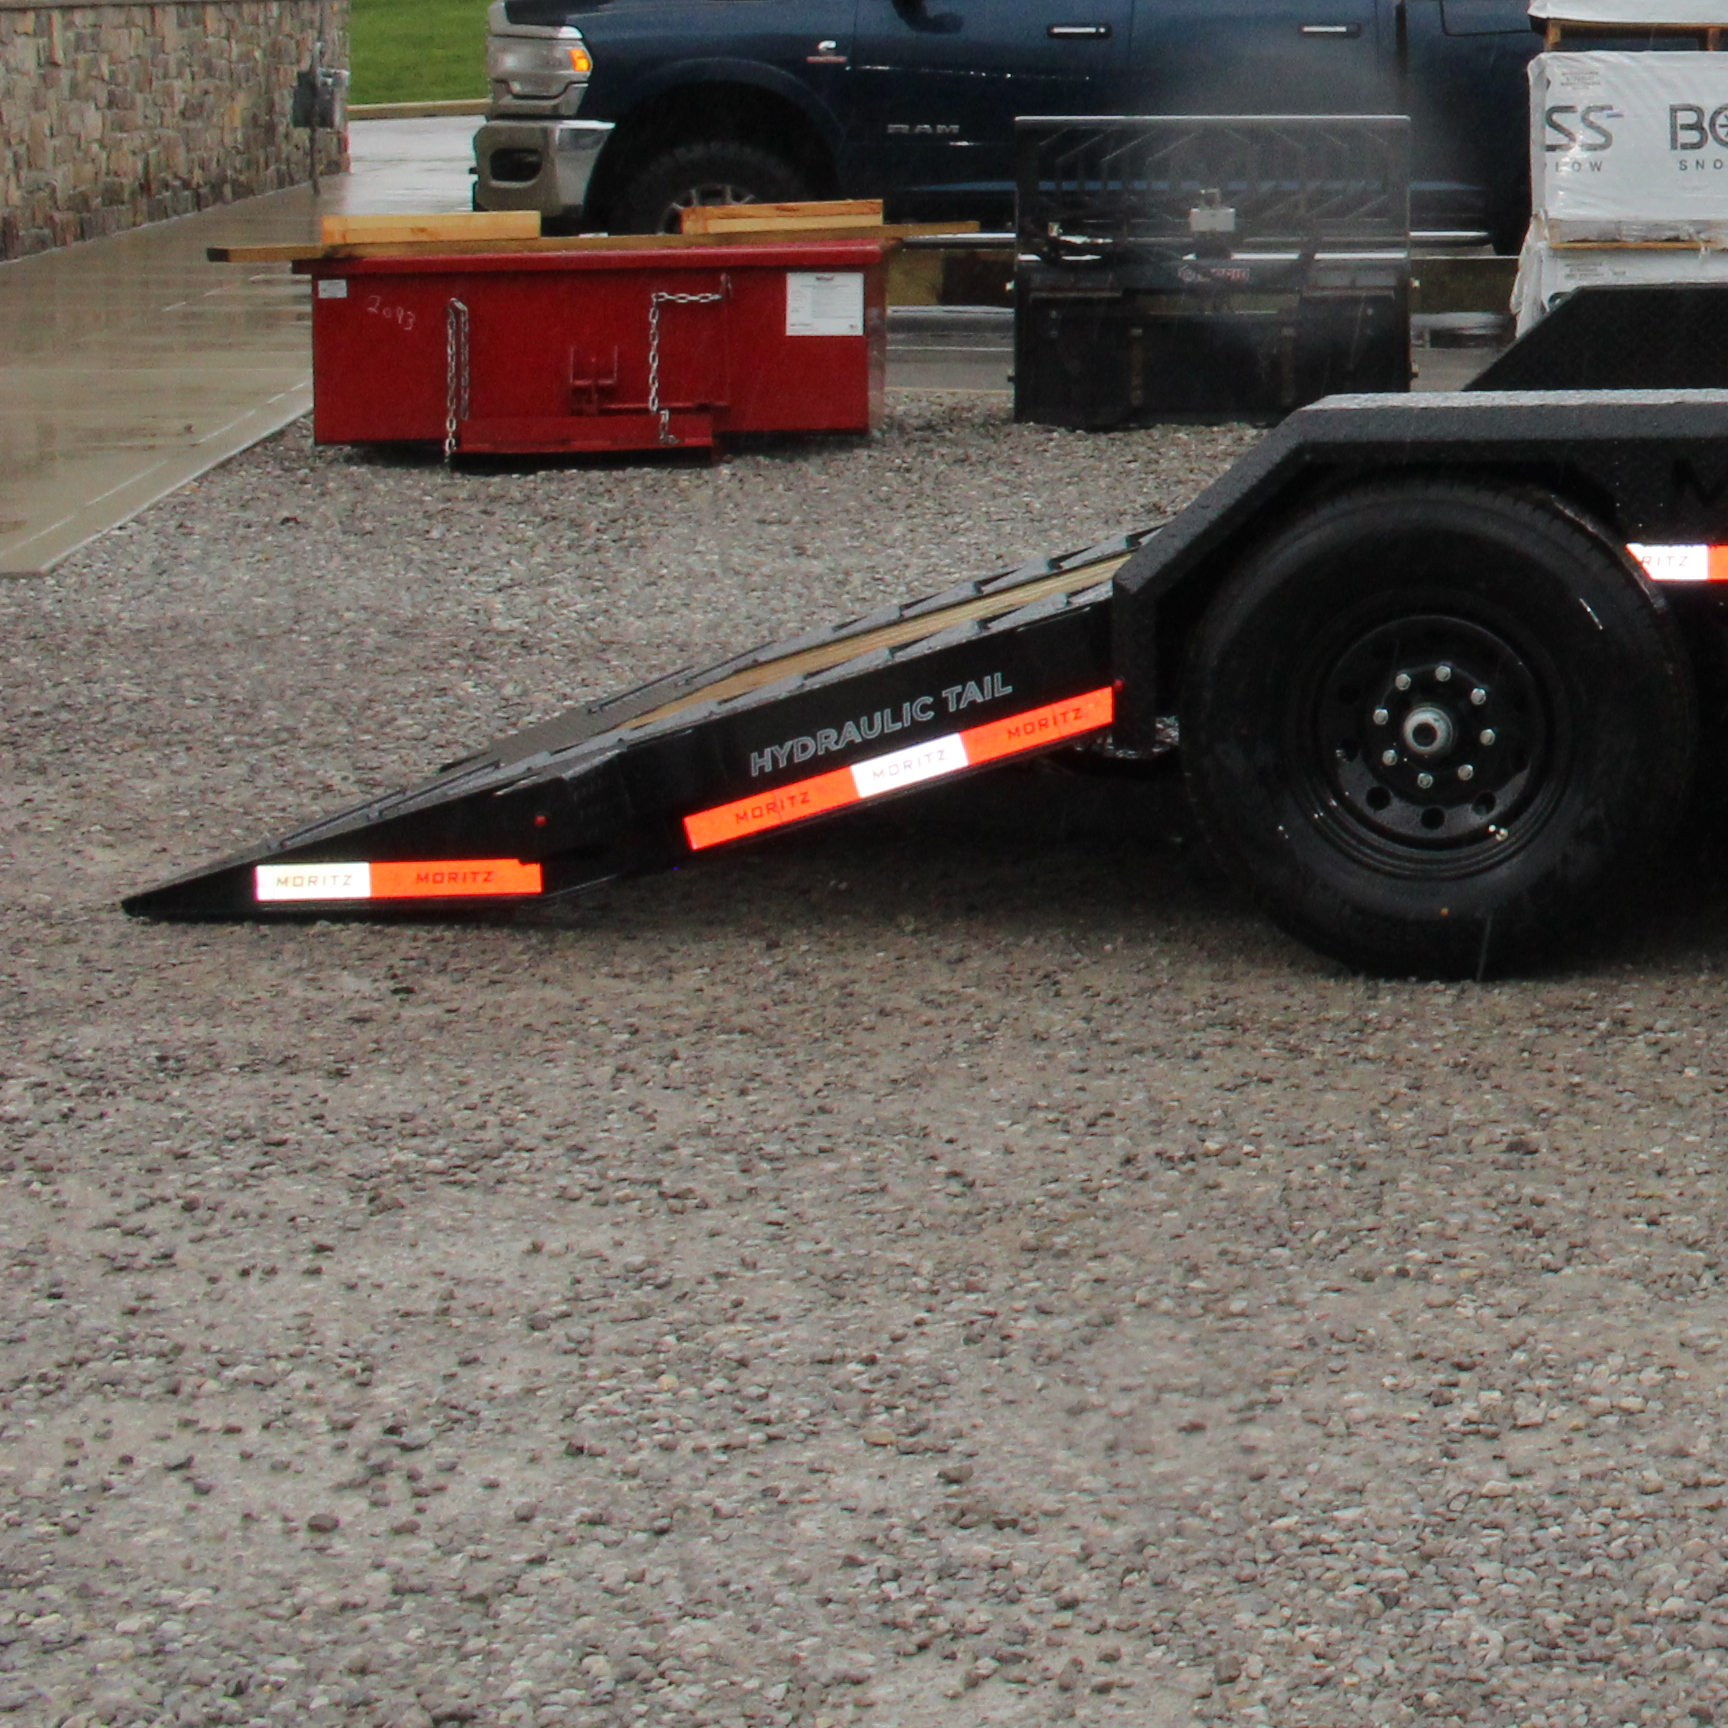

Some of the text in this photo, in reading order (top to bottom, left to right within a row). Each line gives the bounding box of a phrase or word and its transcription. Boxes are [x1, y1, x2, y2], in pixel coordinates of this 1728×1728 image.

[887, 124, 960, 135] RAM
[1545, 104, 1613, 151] SS
[751, 672, 1012, 777] HYDRAULIC TAIL
[1008, 708, 1082, 740] MORITZ
[873, 750, 946, 781] MORITZ
[735, 791, 810, 824] MORITZ
[277, 875, 352, 887] MORITZ
[417, 871, 493, 884] MORITZ
